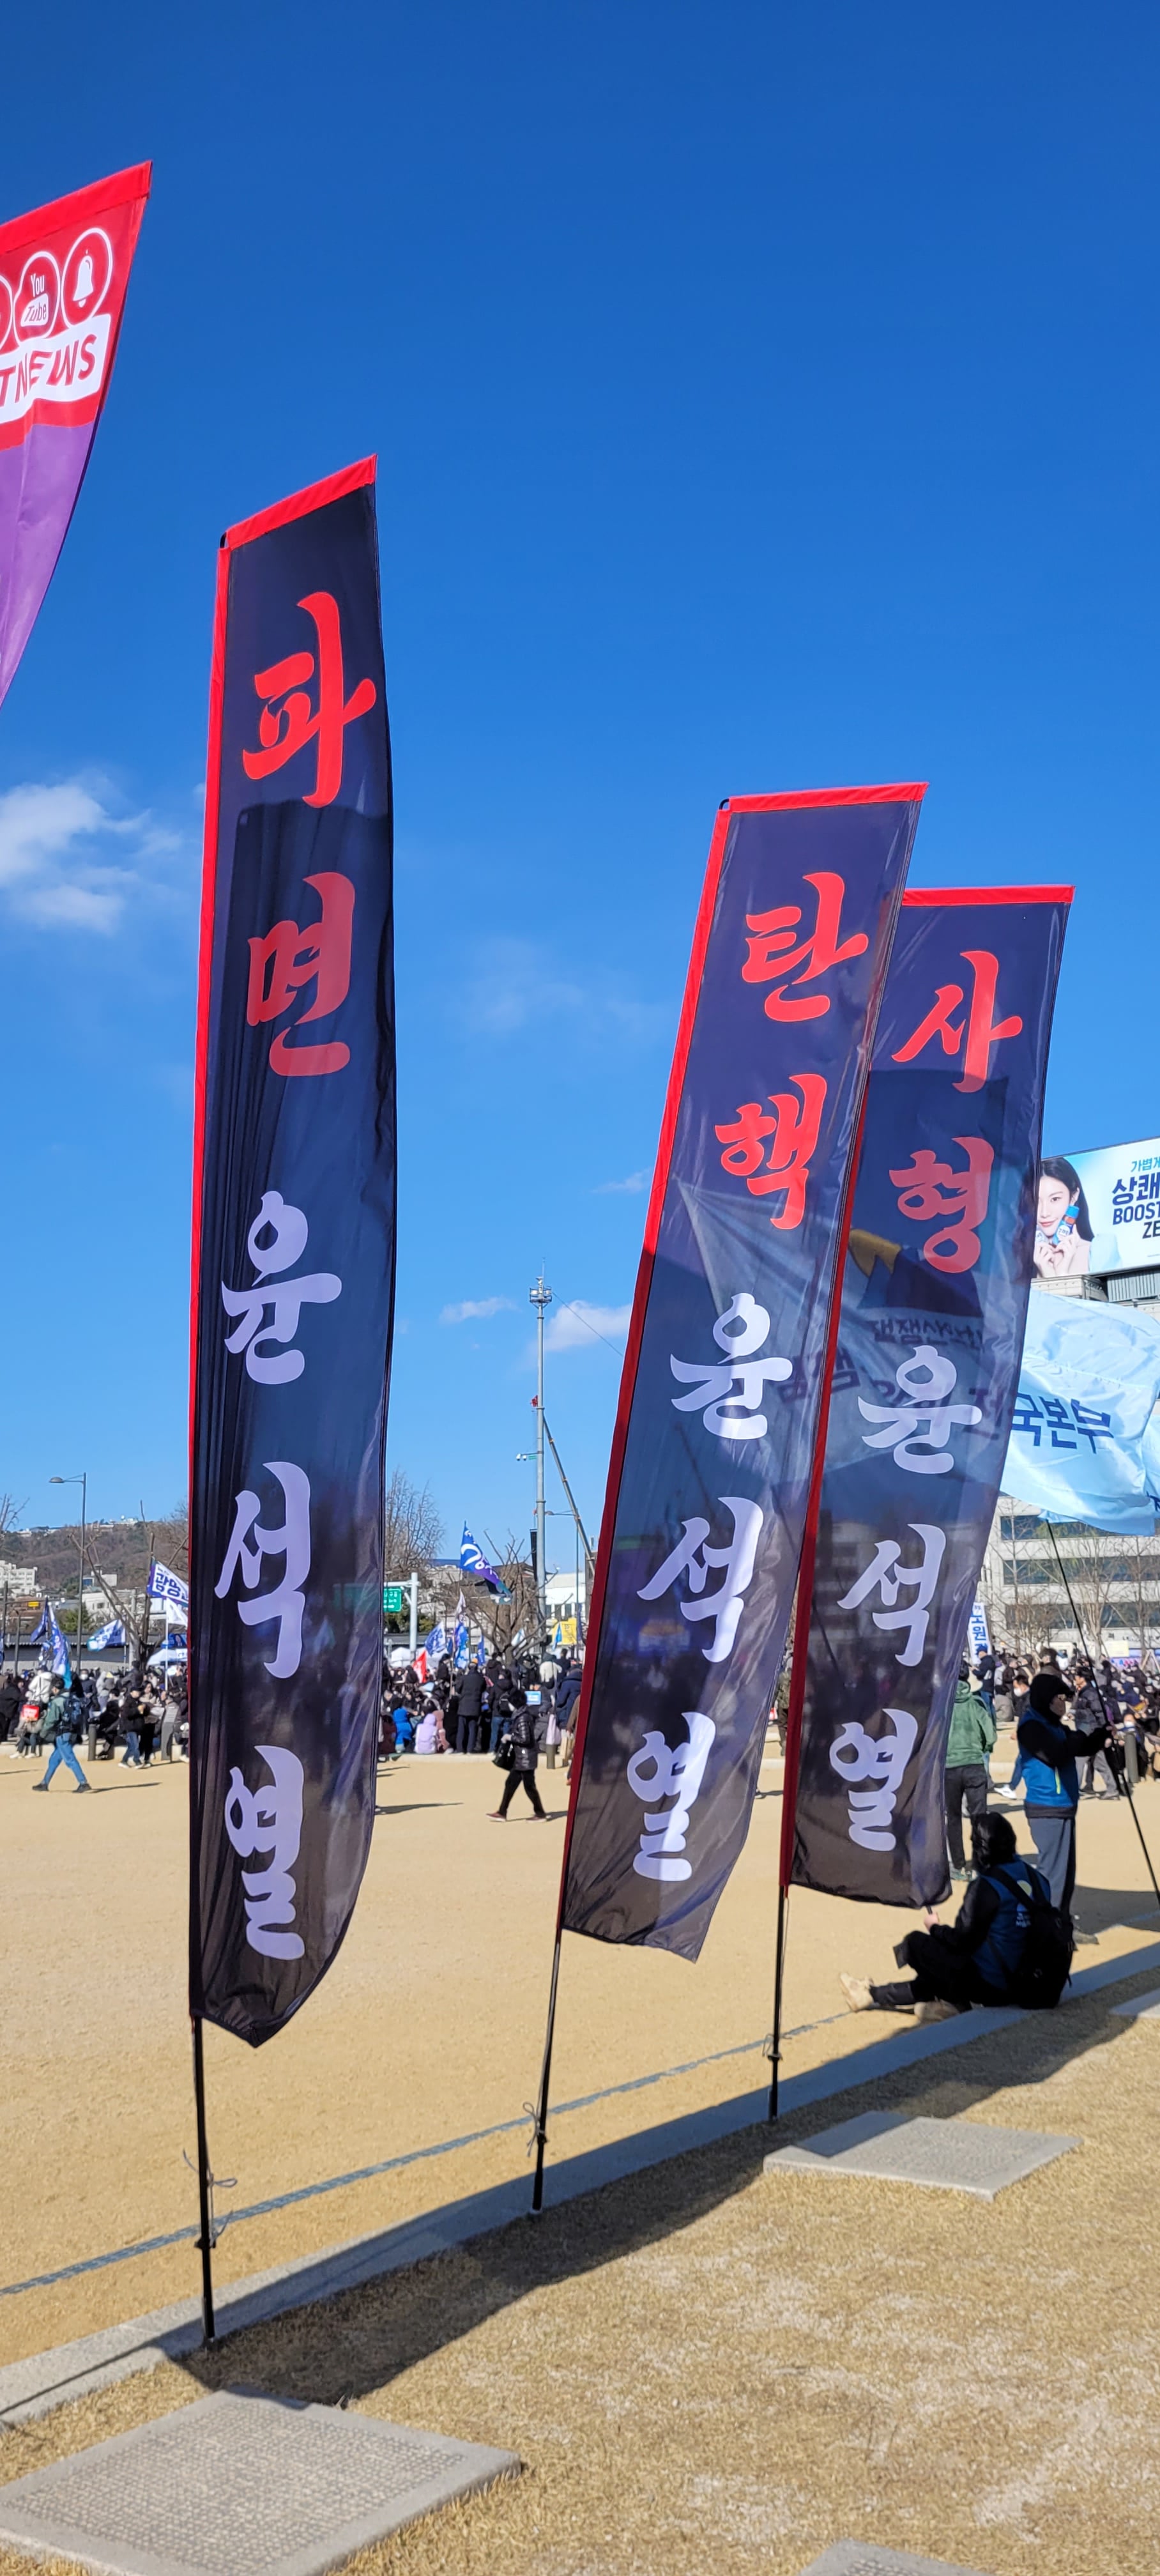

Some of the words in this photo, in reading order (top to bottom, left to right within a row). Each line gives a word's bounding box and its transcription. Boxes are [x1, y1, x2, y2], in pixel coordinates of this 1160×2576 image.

[25, 303, 47, 321] Tube
[31, 274, 45, 296] You
[241, 591, 378, 1077] 파면
[714, 871, 869, 1230] 탄핵
[889, 949, 1024, 1274] 사형
[1112, 1172, 1160, 1206] 상쾌
[214, 1190, 342, 1961] 윤석열
[626, 1292, 794, 1883] 윤석열
[828, 1344, 984, 1852] 윤석열
